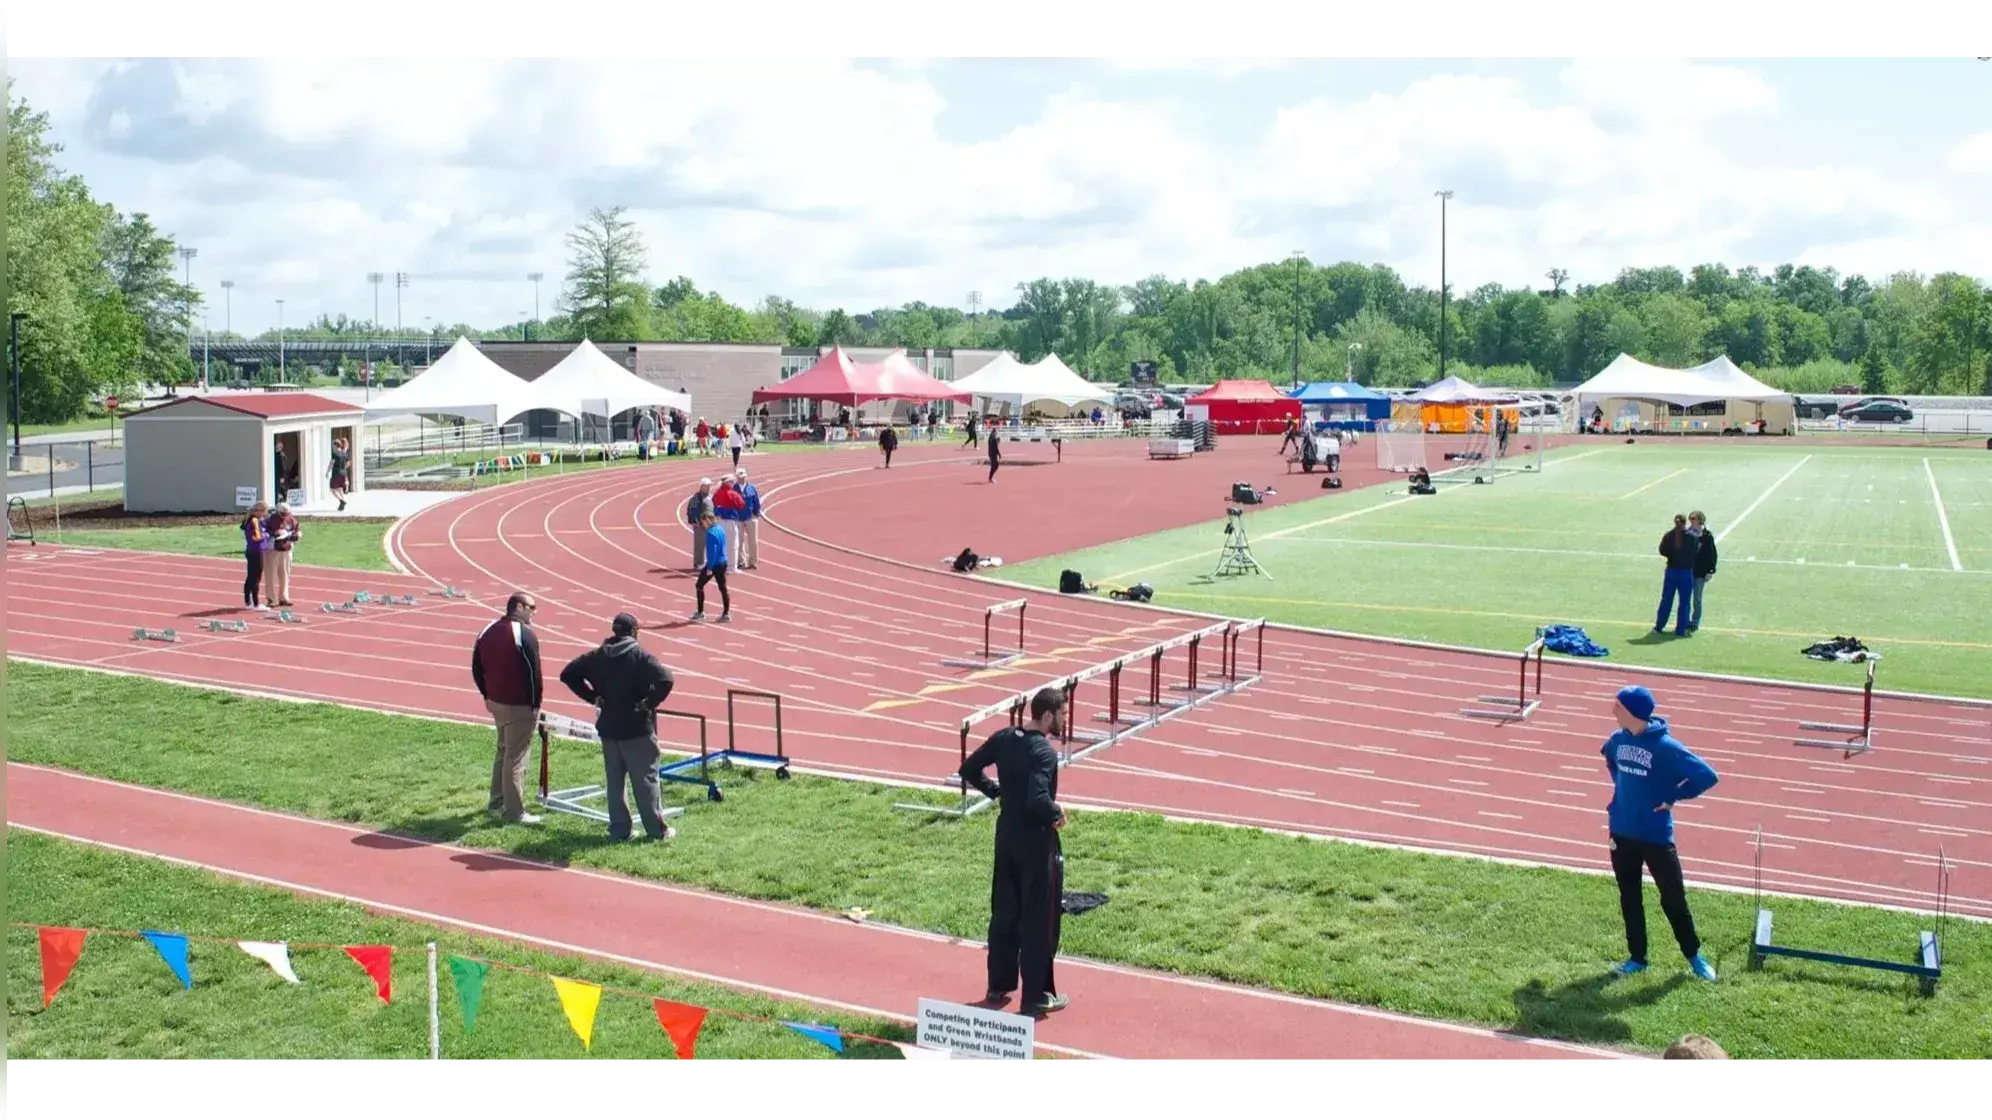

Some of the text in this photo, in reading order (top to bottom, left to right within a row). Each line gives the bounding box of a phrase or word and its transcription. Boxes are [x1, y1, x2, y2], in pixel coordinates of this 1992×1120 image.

[1617, 744, 1653, 769] DRAKE
[925, 1009, 1027, 1036] Competing Participants
[928, 1023, 1023, 1047] and Green Wristbands
[924, 1033, 1026, 1060] ONLY beyond this point
